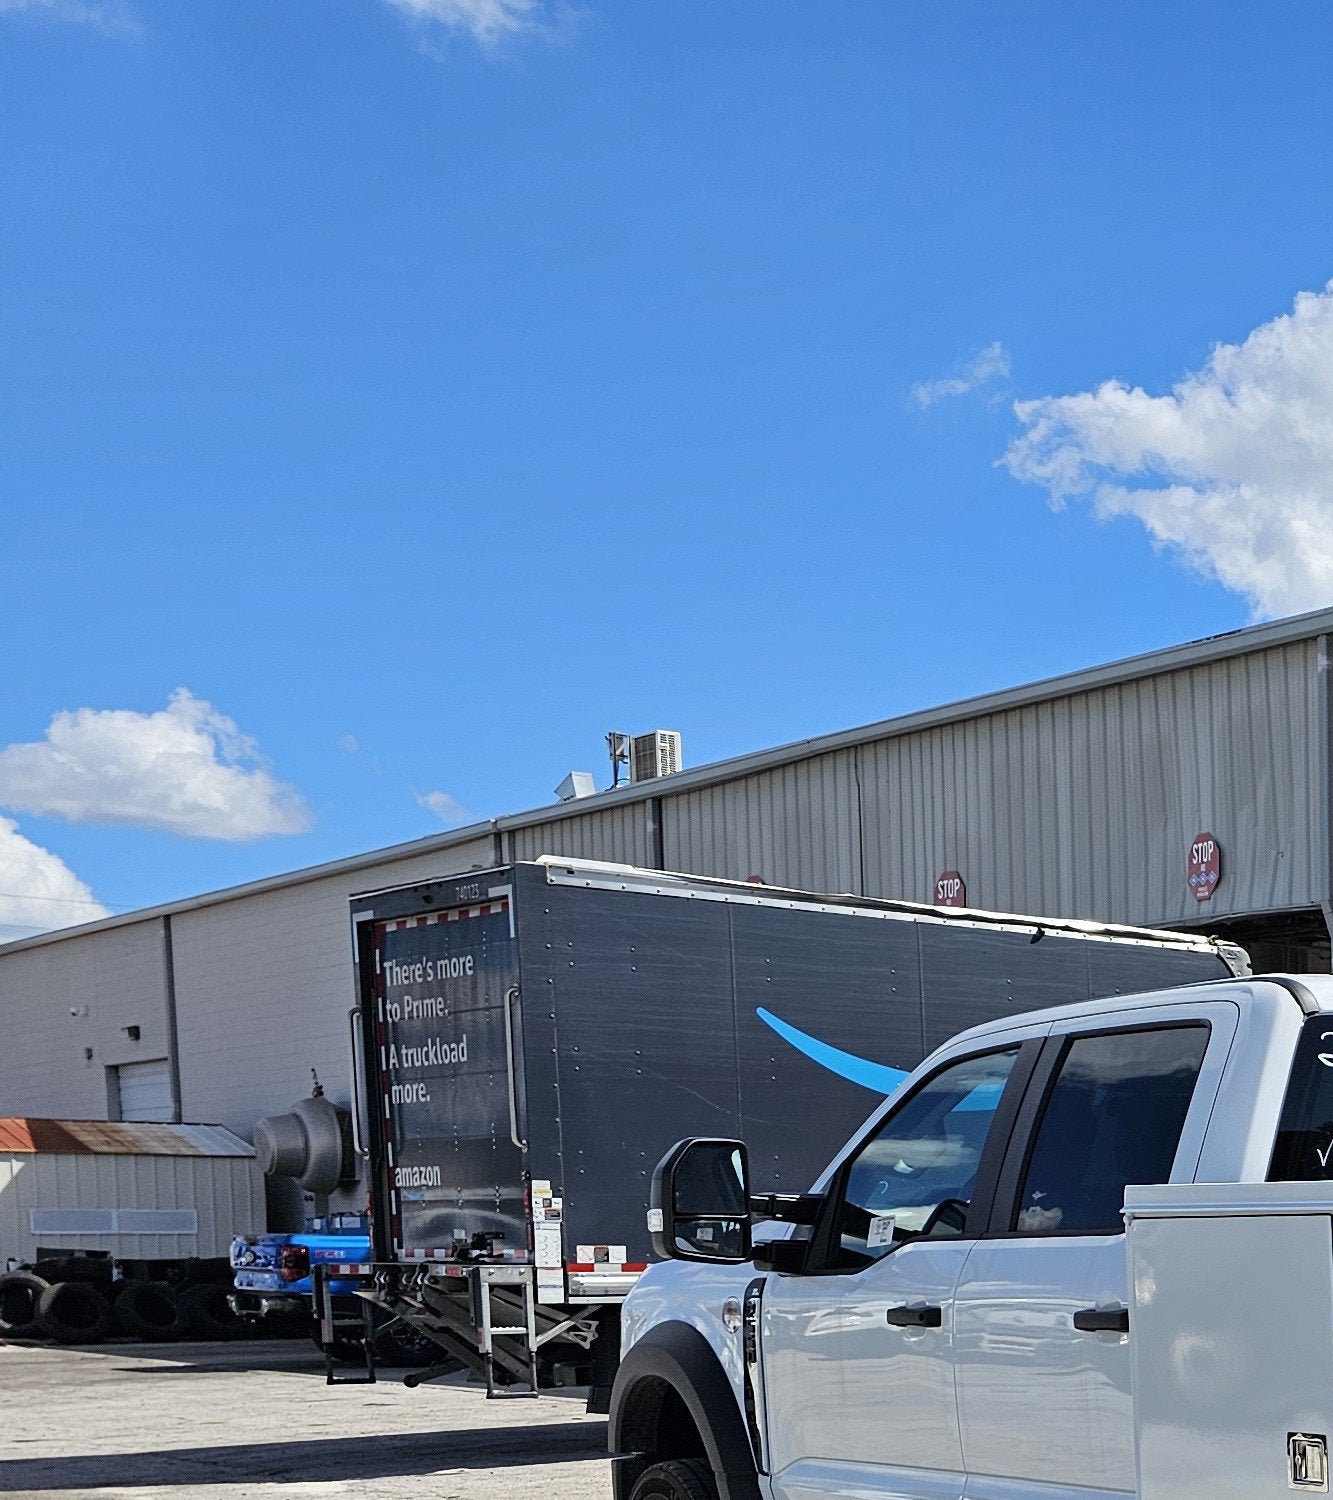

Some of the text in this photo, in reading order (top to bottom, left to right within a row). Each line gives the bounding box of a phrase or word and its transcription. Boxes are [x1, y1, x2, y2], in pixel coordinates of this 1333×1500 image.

[1192, 840, 1213, 864] STOP
[937, 878, 960, 899] STOP
[383, 954, 474, 987] There's more
[386, 995, 448, 1023] to Prime.
[389, 1034, 468, 1069] A truckload
[391, 1082, 430, 1104] more.
[394, 1165, 441, 1187] amazon
